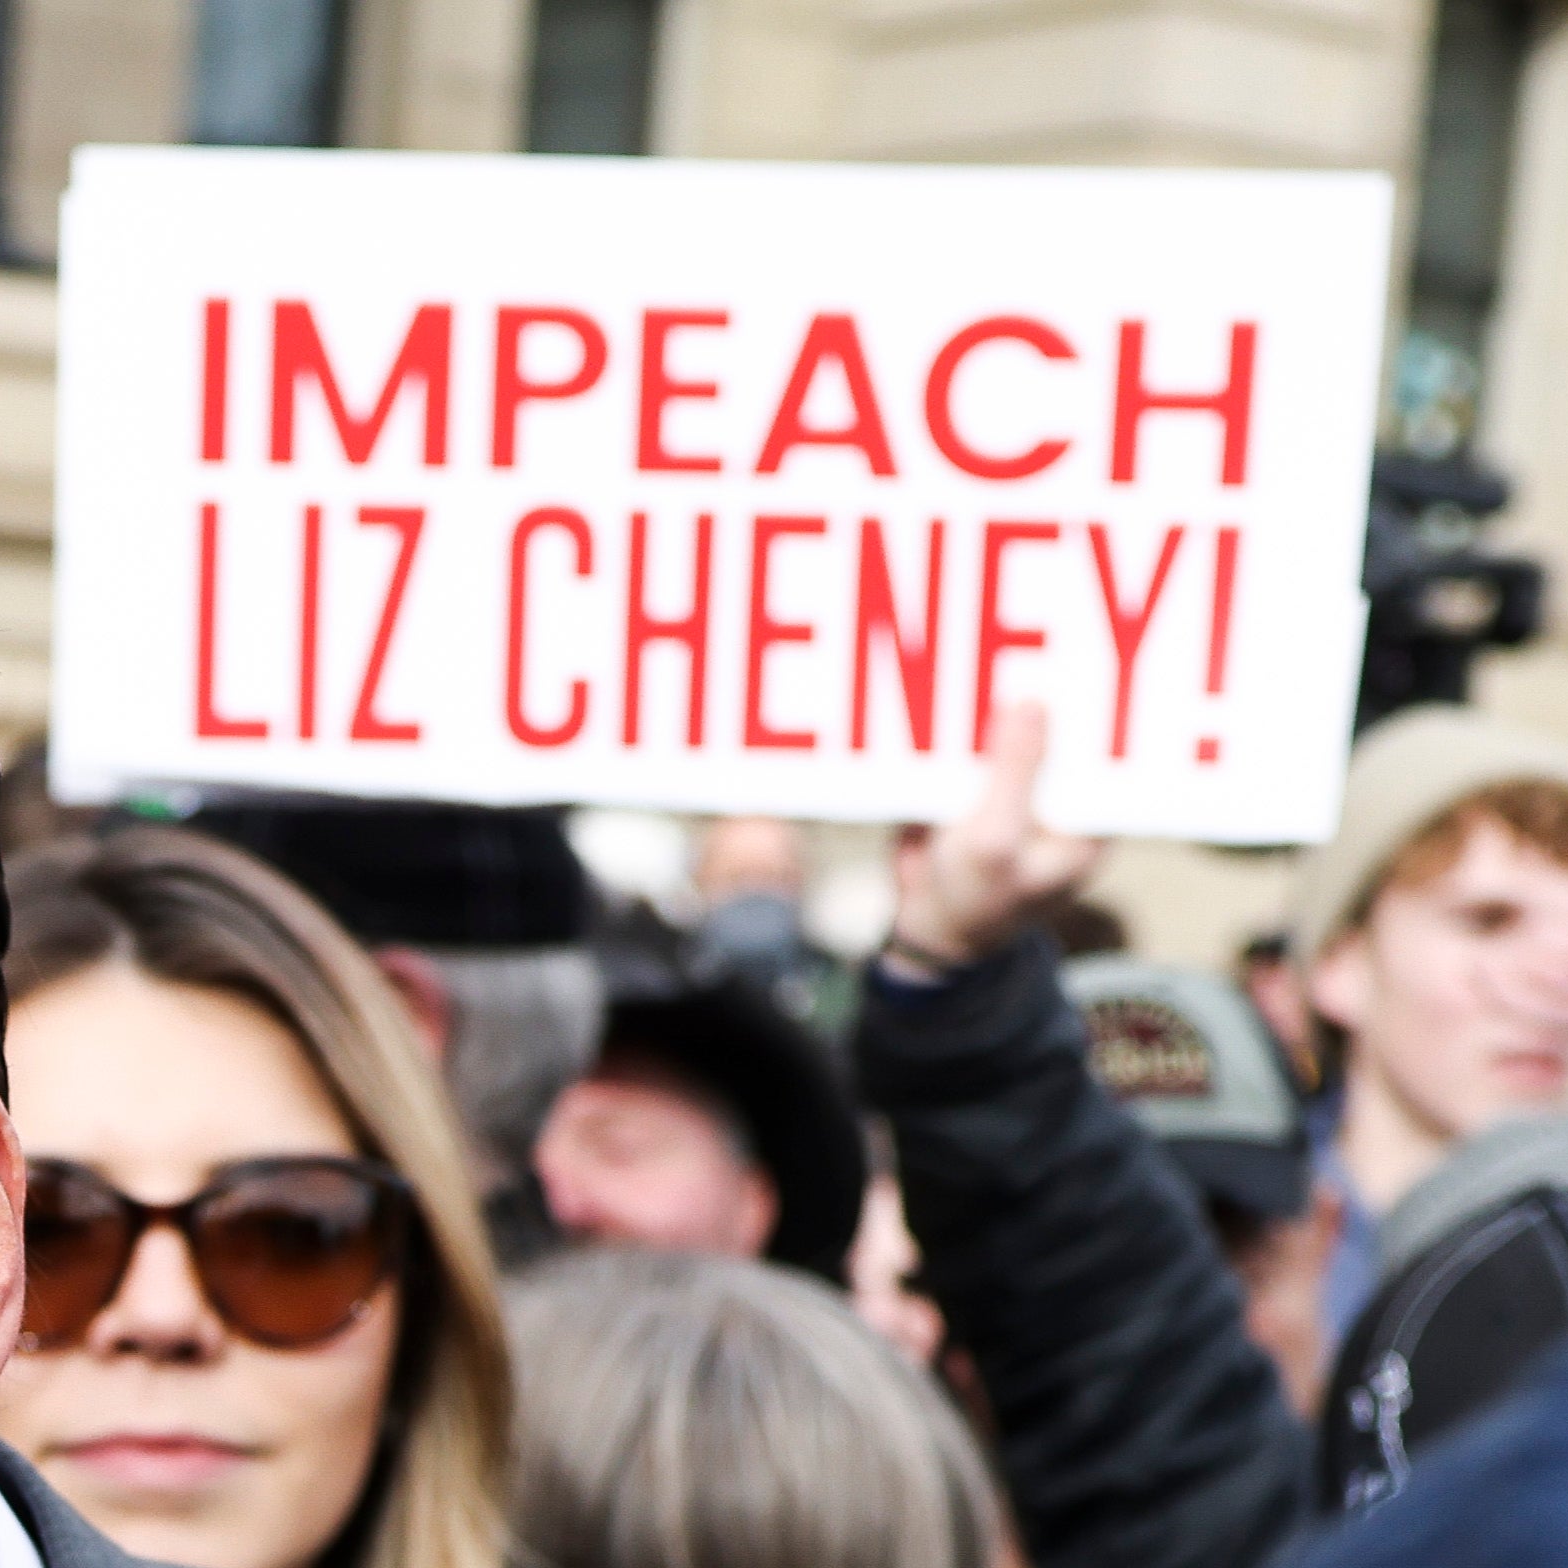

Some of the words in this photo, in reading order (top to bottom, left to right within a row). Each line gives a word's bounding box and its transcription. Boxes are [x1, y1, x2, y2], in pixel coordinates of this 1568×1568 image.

[198, 297, 1260, 488] IMPEACH
[193, 501, 429, 745] LIZ
[502, 504, 1242, 765] CHENEY!
